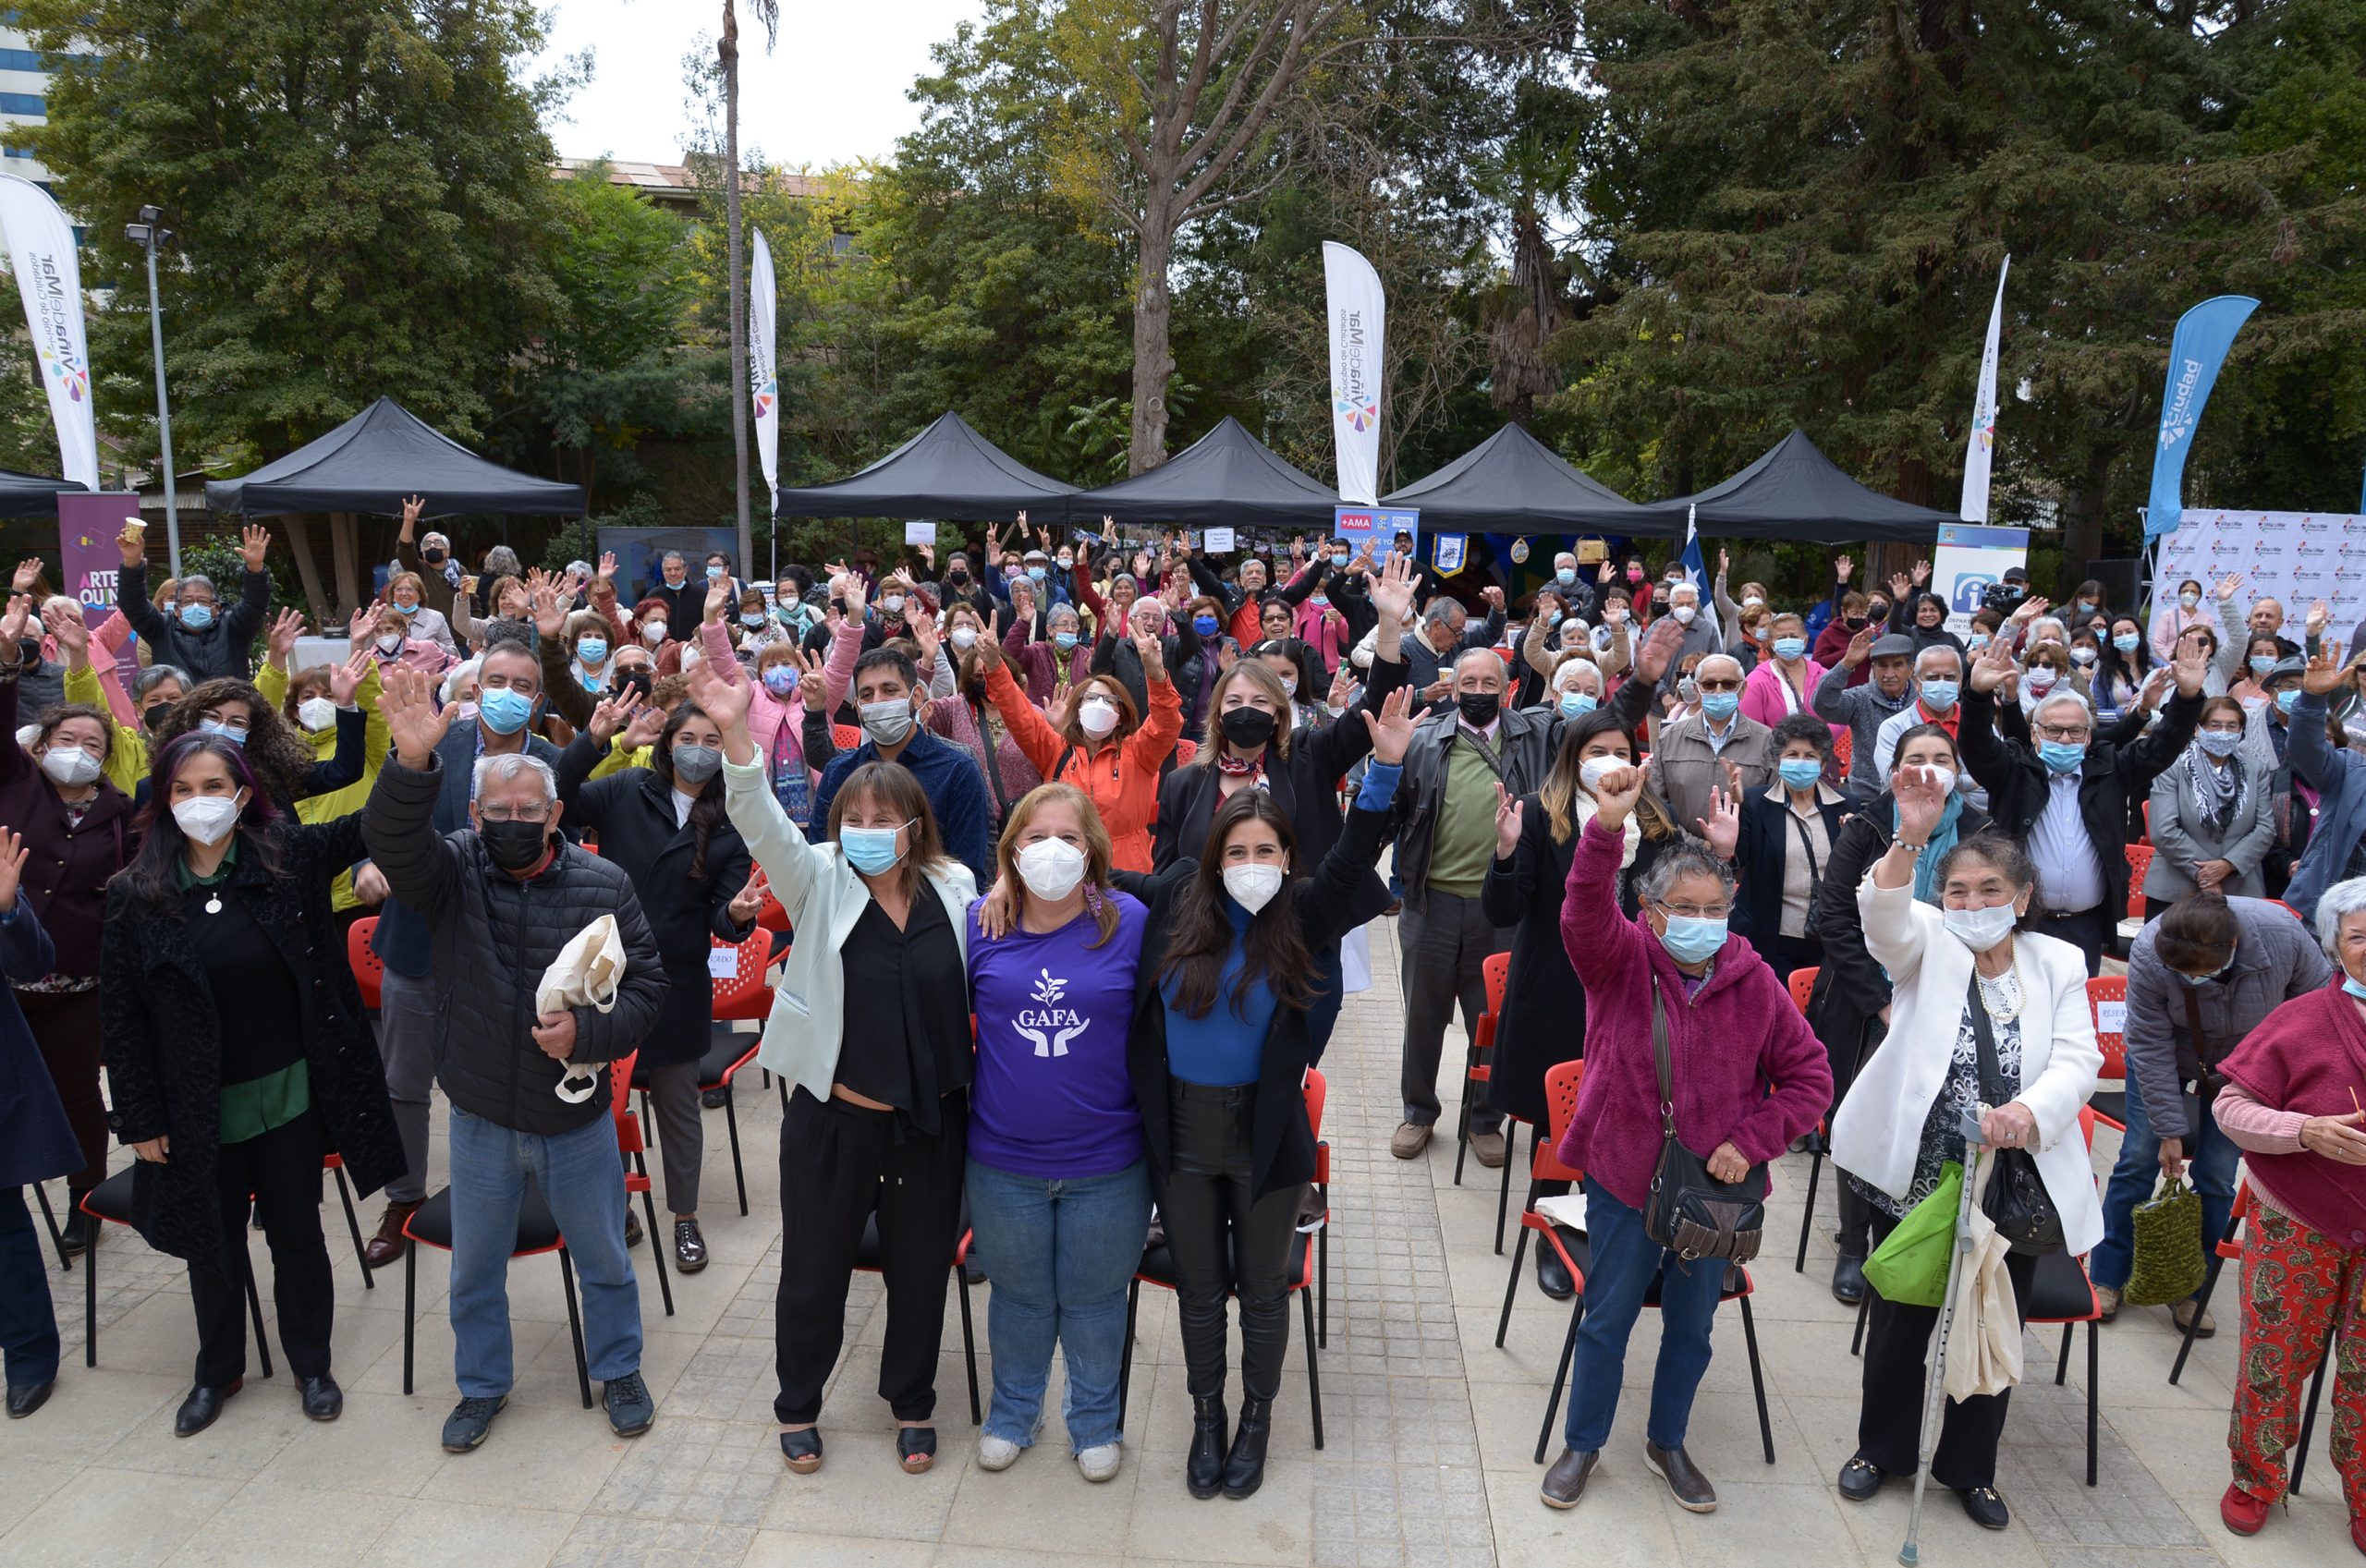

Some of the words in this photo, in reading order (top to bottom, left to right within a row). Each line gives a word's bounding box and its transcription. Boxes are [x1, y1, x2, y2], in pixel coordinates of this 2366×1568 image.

[2166, 359, 2199, 427] Ciudad
[79, 570, 118, 588] ARTE
[1018, 1008, 1081, 1027] GAFA
